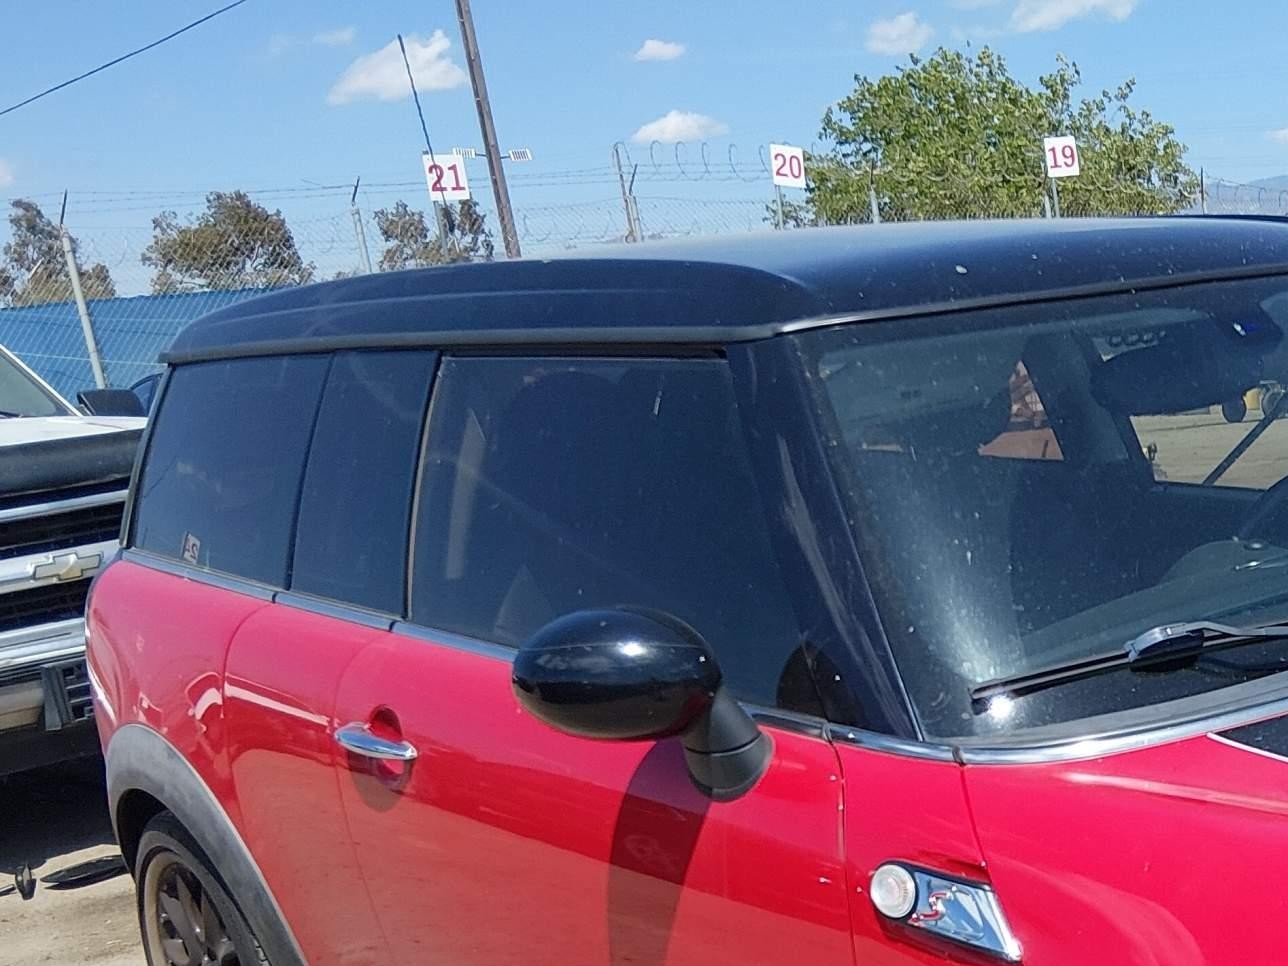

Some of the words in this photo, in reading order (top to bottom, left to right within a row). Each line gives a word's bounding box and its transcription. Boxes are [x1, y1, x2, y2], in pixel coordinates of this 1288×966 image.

[773, 152, 802, 179] 20
[1047, 144, 1076, 169] 19
[427, 163, 467, 192] 21
